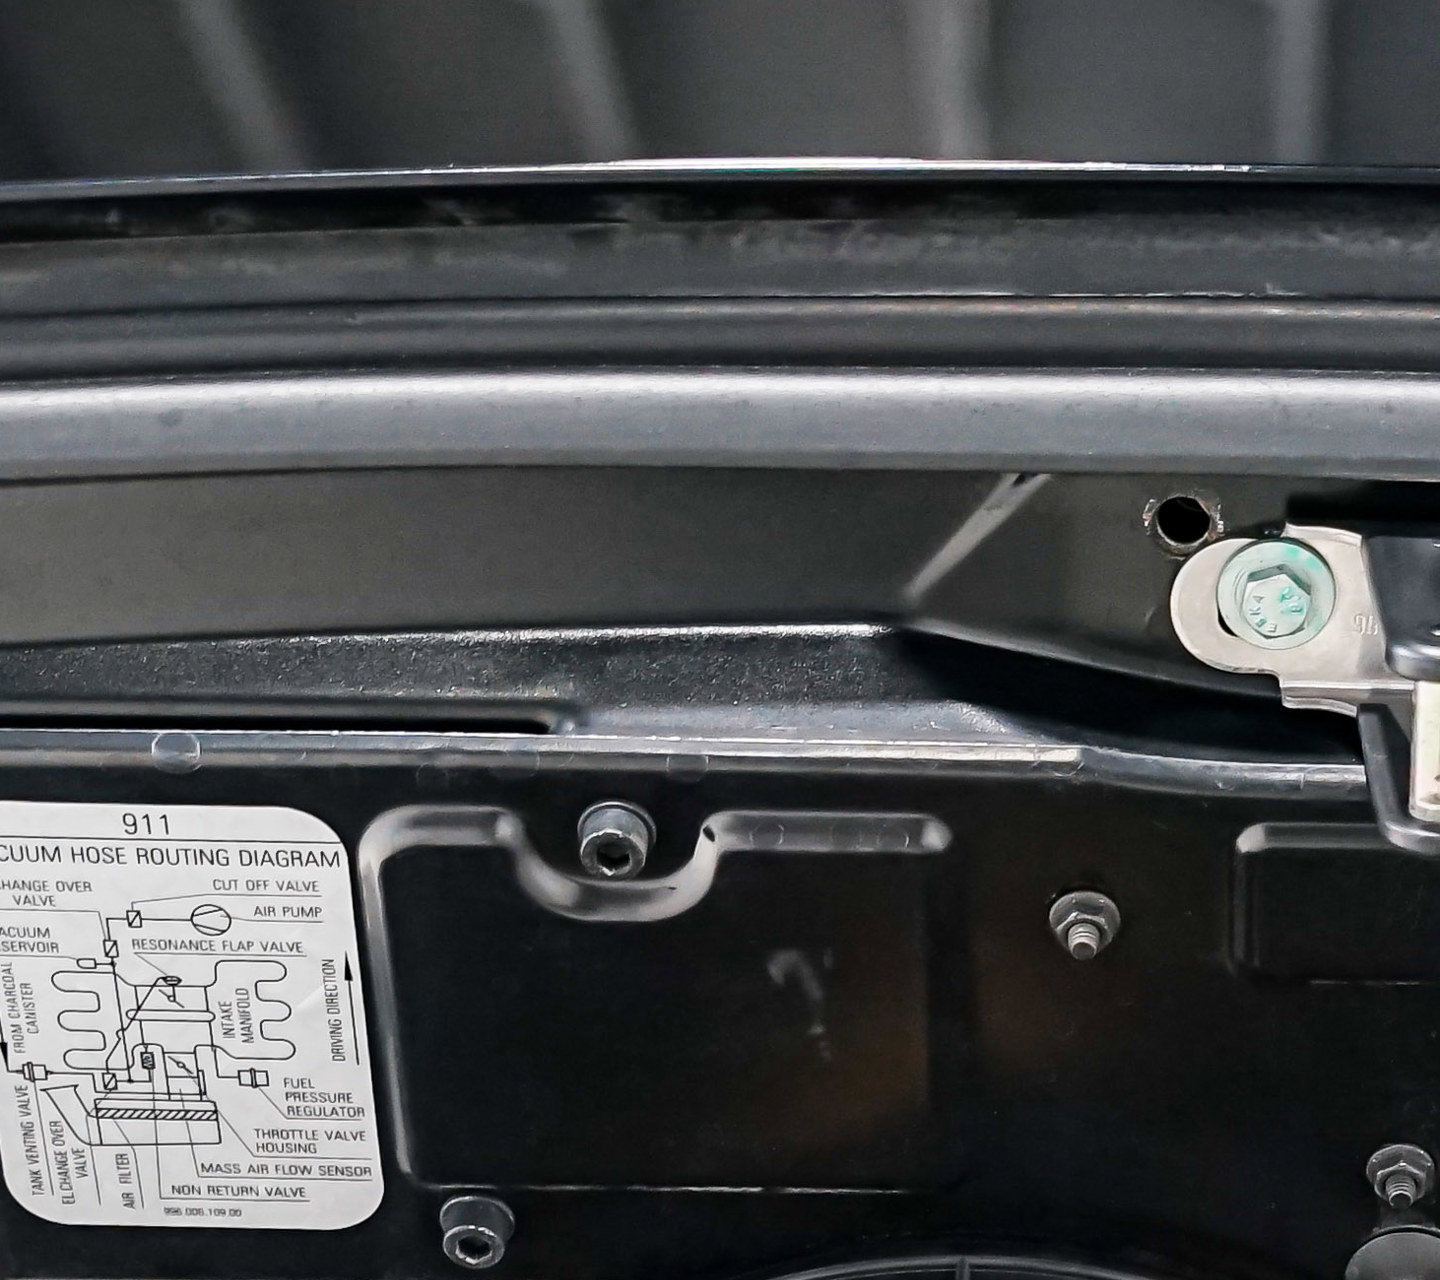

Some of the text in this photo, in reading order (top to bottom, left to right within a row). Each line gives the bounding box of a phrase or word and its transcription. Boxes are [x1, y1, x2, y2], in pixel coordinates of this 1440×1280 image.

[123, 813, 170, 835] 911
[71, 847, 127, 865] HOSE
[137, 849, 229, 866] ROUTING
[239, 850, 341, 868] DIAGRAM
[56, 881, 92, 892] OVER
[213, 879, 319, 892] CUT OFF VALVE
[12, 895, 56, 907] VALVE
[254, 906, 322, 919] AIR PUMP
[132, 939, 303, 953] RESONANCE FLAP VALVE
[1, 962, 26, 1053] FROM CHARCOAL
[20, 982, 39, 1033] CANISTER
[322, 960, 346, 1061] DRIVING DIRECTION
[218, 1001, 236, 1038] INTAKE
[235, 988, 254, 1044] MANIFOLD
[284, 1078, 315, 1089] FUEL
[285, 1092, 353, 1104] PRESSURE
[287, 1106, 365, 1117] REGULATOR
[15, 1085, 45, 1196] TANK VENTING VALVE
[254, 1128, 366, 1141] THROTTLE VALVE
[256, 1142, 317, 1154] HOUSING
[72, 1147, 89, 1178] VALVE
[201, 1163, 372, 1176] MASS AIR FLOW SENSOR
[171, 1185, 305, 1197] NON RETURN VALVE
